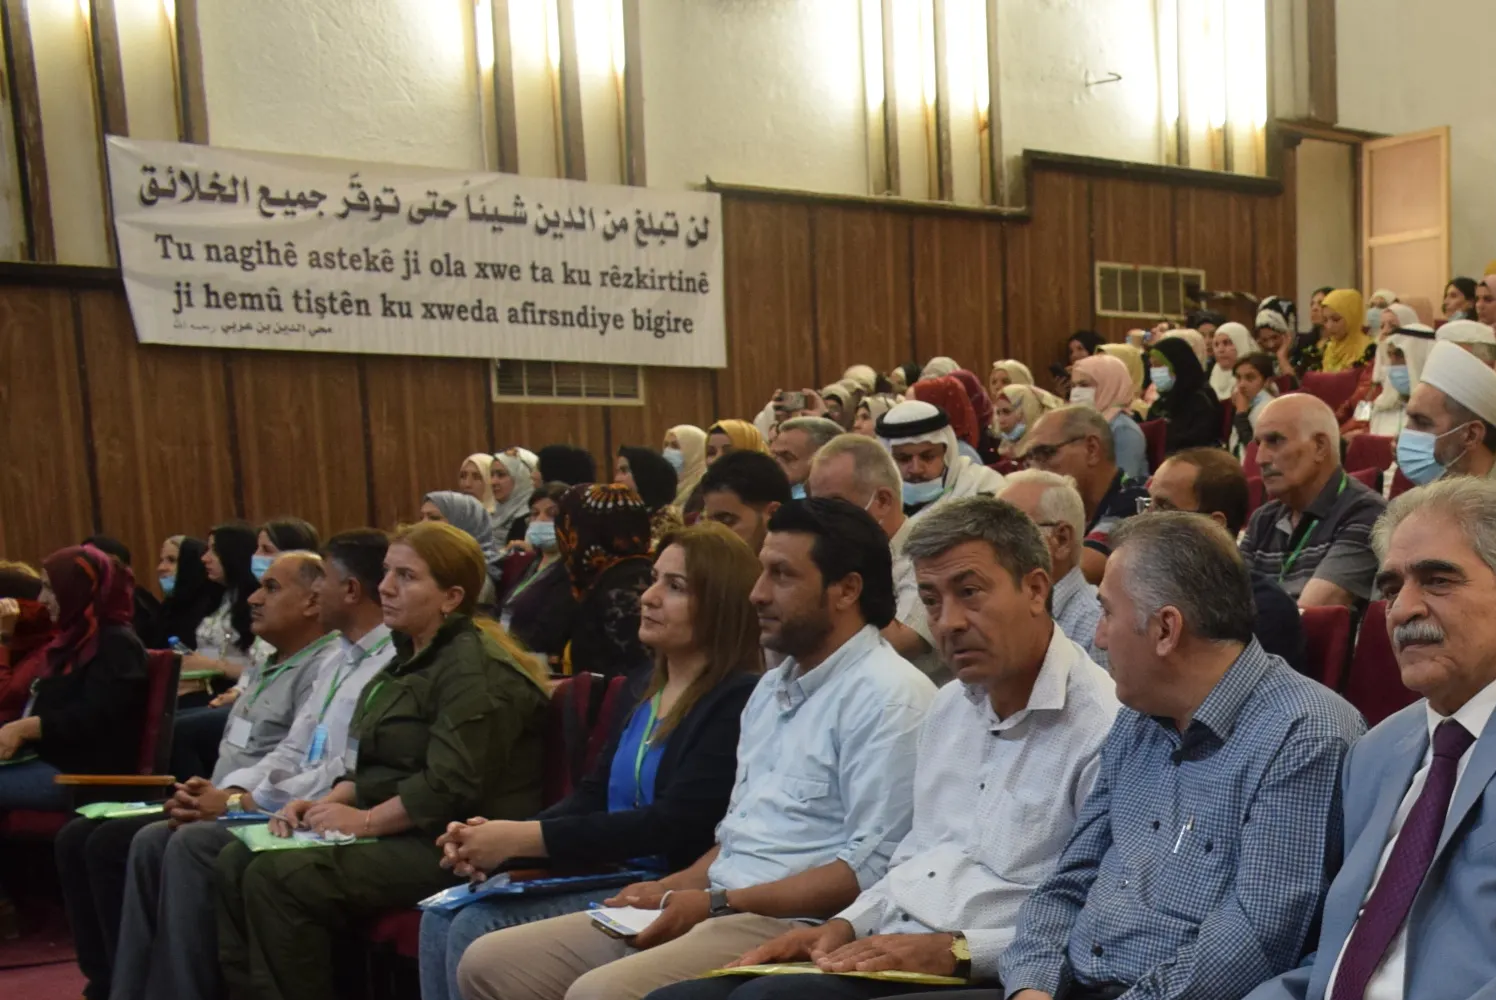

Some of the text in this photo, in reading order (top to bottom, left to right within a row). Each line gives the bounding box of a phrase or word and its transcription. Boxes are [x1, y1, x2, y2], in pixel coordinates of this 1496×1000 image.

[137, 163, 251, 209] الخلائق
[256, 184, 328, 220] جميع
[406, 189, 459, 227] حتى
[533, 202, 596, 240] الدين
[601, 208, 630, 243] من
[633, 208, 680, 250] تبلغ
[685, 214, 711, 249] لن
[153, 232, 710, 295] Tu nagihê astekê ji ola xwe ta ku rêzkirtinê
[171, 280, 694, 340] ji hemû tiştên ku xweda afirsndiye bigire
